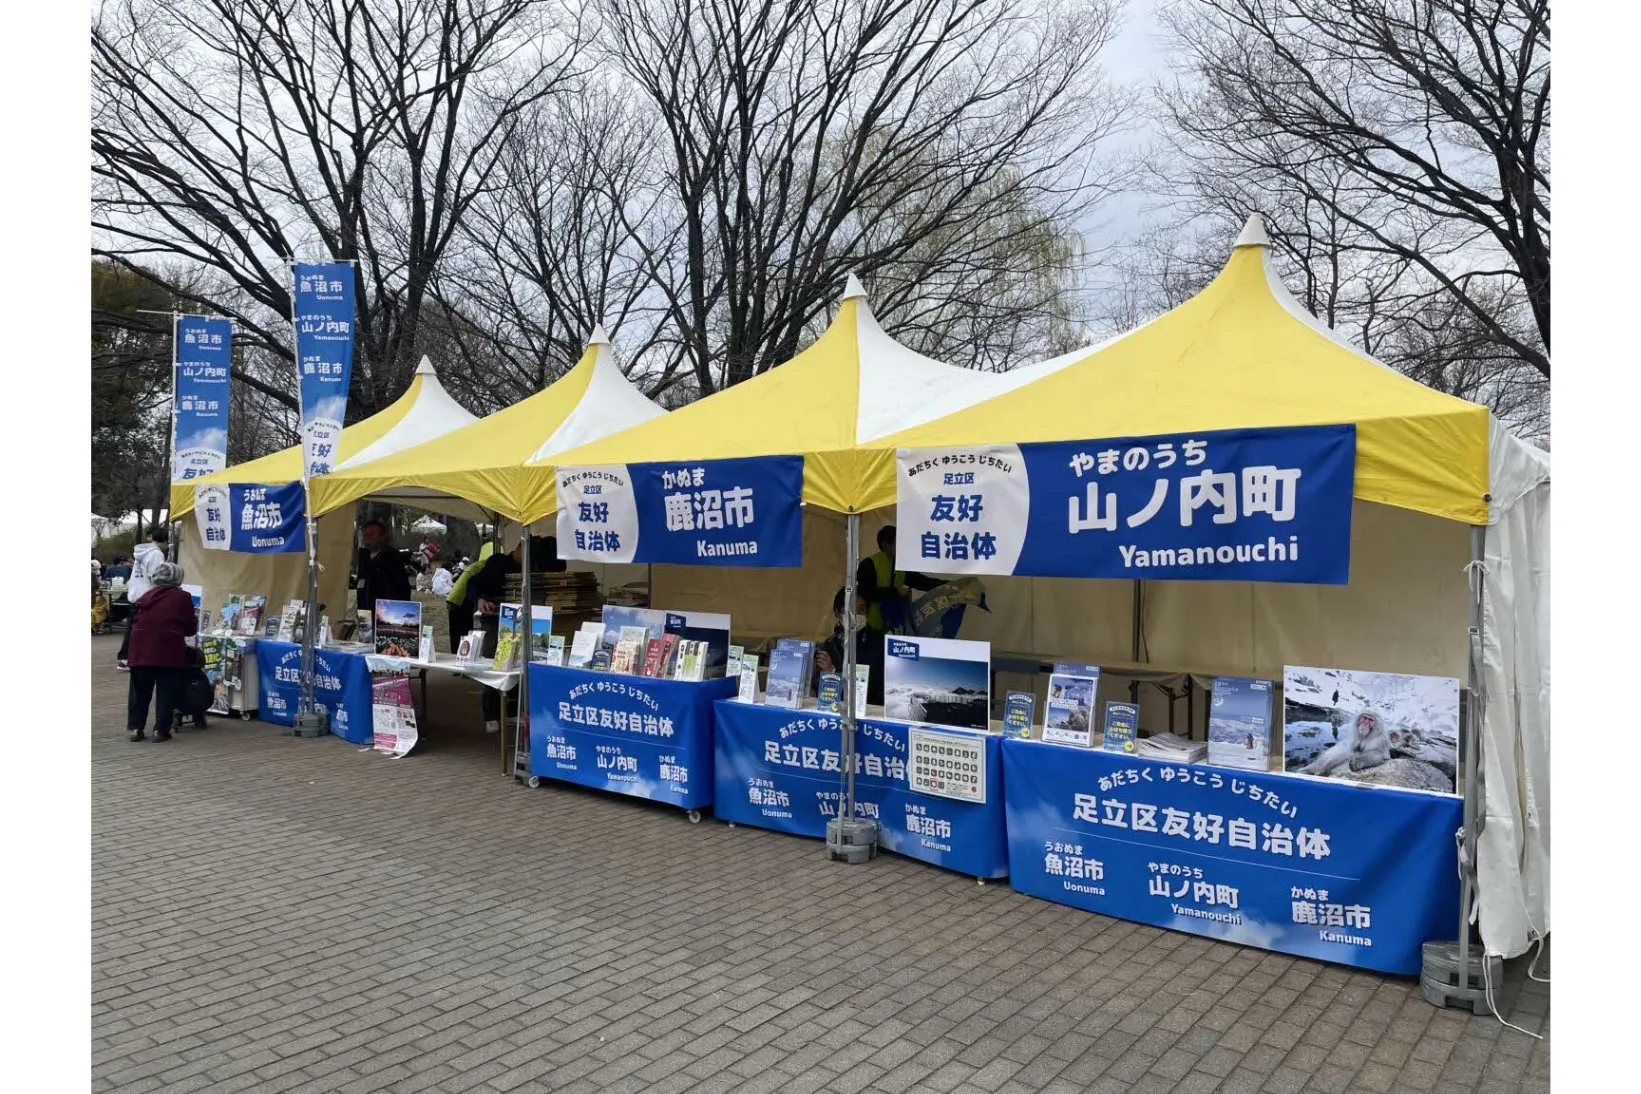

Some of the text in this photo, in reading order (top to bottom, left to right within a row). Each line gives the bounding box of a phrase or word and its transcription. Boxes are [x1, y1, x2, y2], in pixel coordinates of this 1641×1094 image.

[300, 281, 343, 293] 魚沼市
[301, 321, 350, 333] 山ノ内町
[184, 334, 222, 344] 魚沼市
[183, 367, 227, 377] 山ノ内町
[304, 362, 343, 375] 鹿沼市
[182, 401, 219, 410] 鹿沼市
[908, 454, 1012, 477] あだちく ゆうこう じちたい
[1069, 439, 1208, 478] やまのうち
[562, 471, 624, 488] あだちく ゆうこう じちたい
[661, 467, 705, 490] かぬま
[943, 472, 975, 485] 足立区
[583, 485, 602, 494] 足立区
[664, 486, 754, 531] 鹿沼市
[930, 494, 983, 522] 友好
[1067, 465, 1302, 535] 山ノ内町
[241, 501, 283, 530] 魚沼市
[578, 501, 609, 523] 友好
[252, 536, 285, 548] Uonuma
[575, 529, 621, 551] 自治体
[696, 540, 758, 557] Kanuma
[921, 531, 997, 560] 自治体
[1118, 535, 1298, 568] Yamanouchi
[569, 681, 658, 711] あだちく ゆうこう じちたい
[559, 701, 675, 738] 足立区友好自治体
[779, 719, 815, 739] あだちく
[863, 724, 906, 752] じちたい
[547, 743, 577, 760] 魚沼市
[597, 754, 638, 772] 山ノ内町
[660, 764, 688, 783] 鹿沼市
[748, 778, 774, 788] うおぬま
[748, 787, 790, 807] 魚沼市
[1098, 766, 1298, 819] あだちく ゆうこう じちたい
[762, 808, 792, 819] Uonuma
[905, 803, 927, 815] かぬま
[906, 814, 951, 839] 鹿沼市
[1073, 793, 1331, 861] 足立区友好自治体
[921, 837, 951, 852] Kanuma
[1045, 841, 1083, 856] うおぬま
[1044, 853, 1104, 881] 魚沼市
[1147, 862, 1204, 880] やまのうち
[1063, 880, 1106, 896] Uonuma
[1149, 874, 1239, 909] 山ノ内町
[1290, 885, 1329, 901] かぬま
[1171, 903, 1242, 925] Yamanouchi
[1292, 900, 1371, 929] 鹿沼市
[1319, 930, 1372, 947] Kanuma
